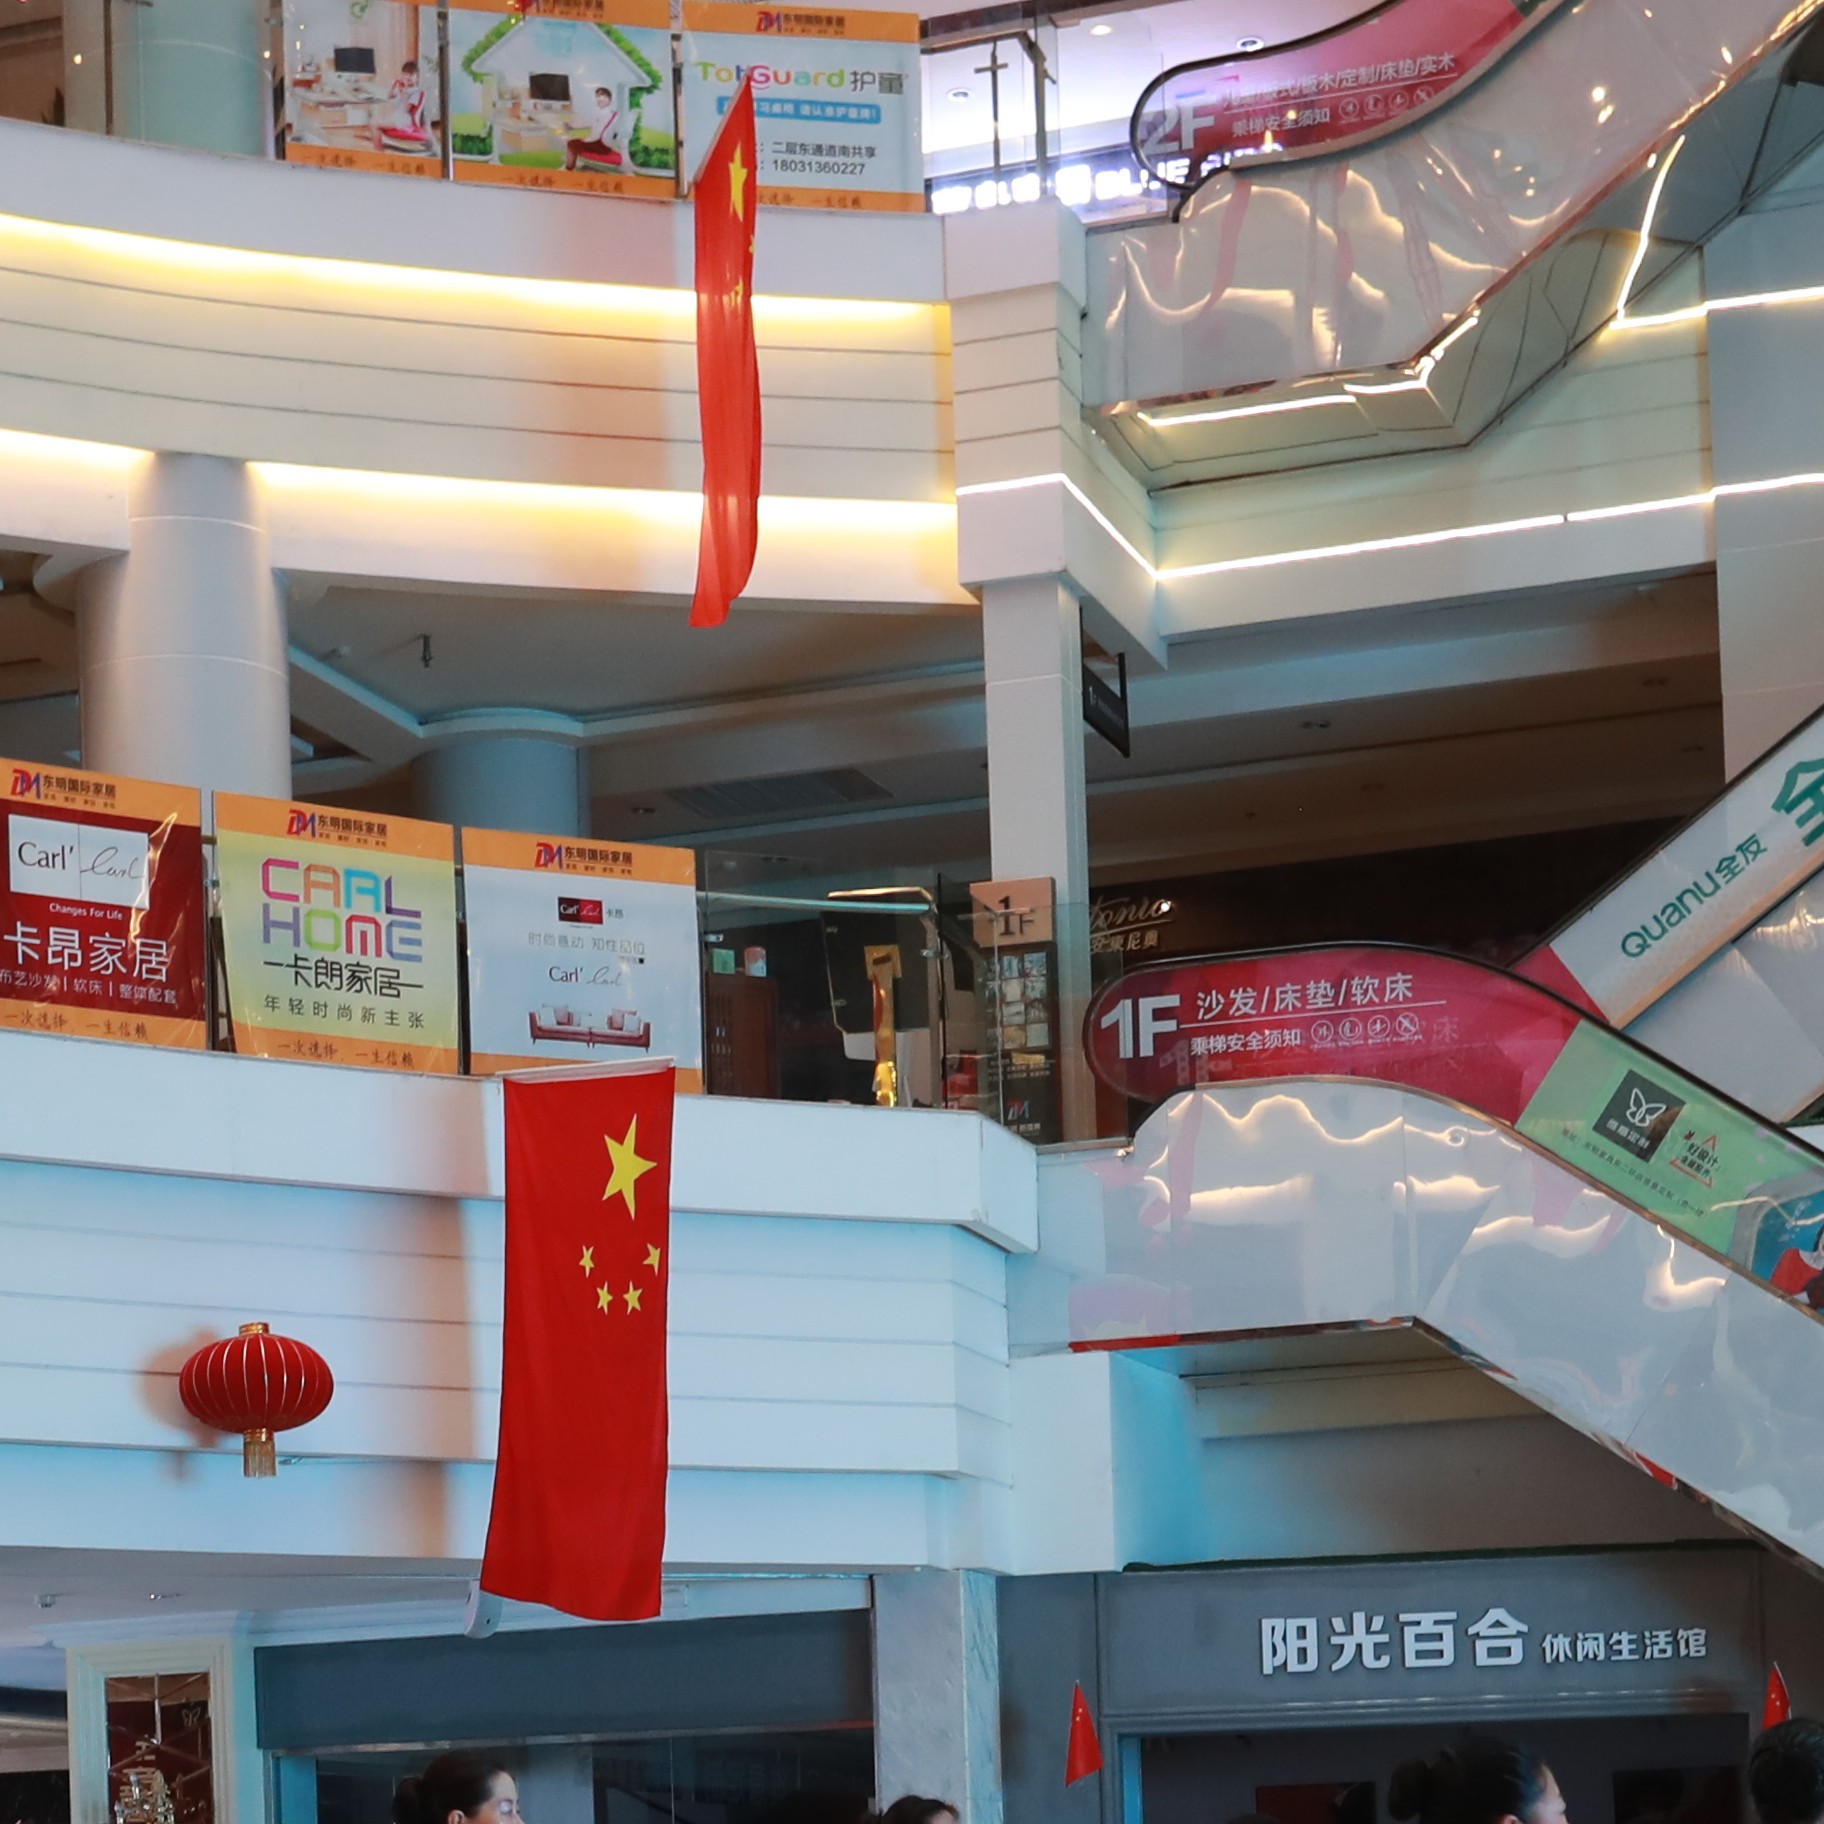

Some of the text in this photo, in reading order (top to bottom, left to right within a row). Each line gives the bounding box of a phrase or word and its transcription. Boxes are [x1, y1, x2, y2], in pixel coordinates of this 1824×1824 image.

[42, 773, 117, 798] 东明国际家居
[316, 814, 388, 837] 东明国际家居
[49, 902, 123, 921] Changes For Life
[262, 902, 422, 963] HOME
[3, 920, 171, 983] 卡昂家居
[264, 993, 425, 1030] 年轻时尚新主张
[1196, 972, 1414, 1022] 沙发/床垫/软床
[1100, 993, 1182, 1059] 1F
[1190, 1027, 1302, 1057] 乘梯安全须知
[1260, 1606, 1708, 1676] 阳光百合 休闲生活馆
